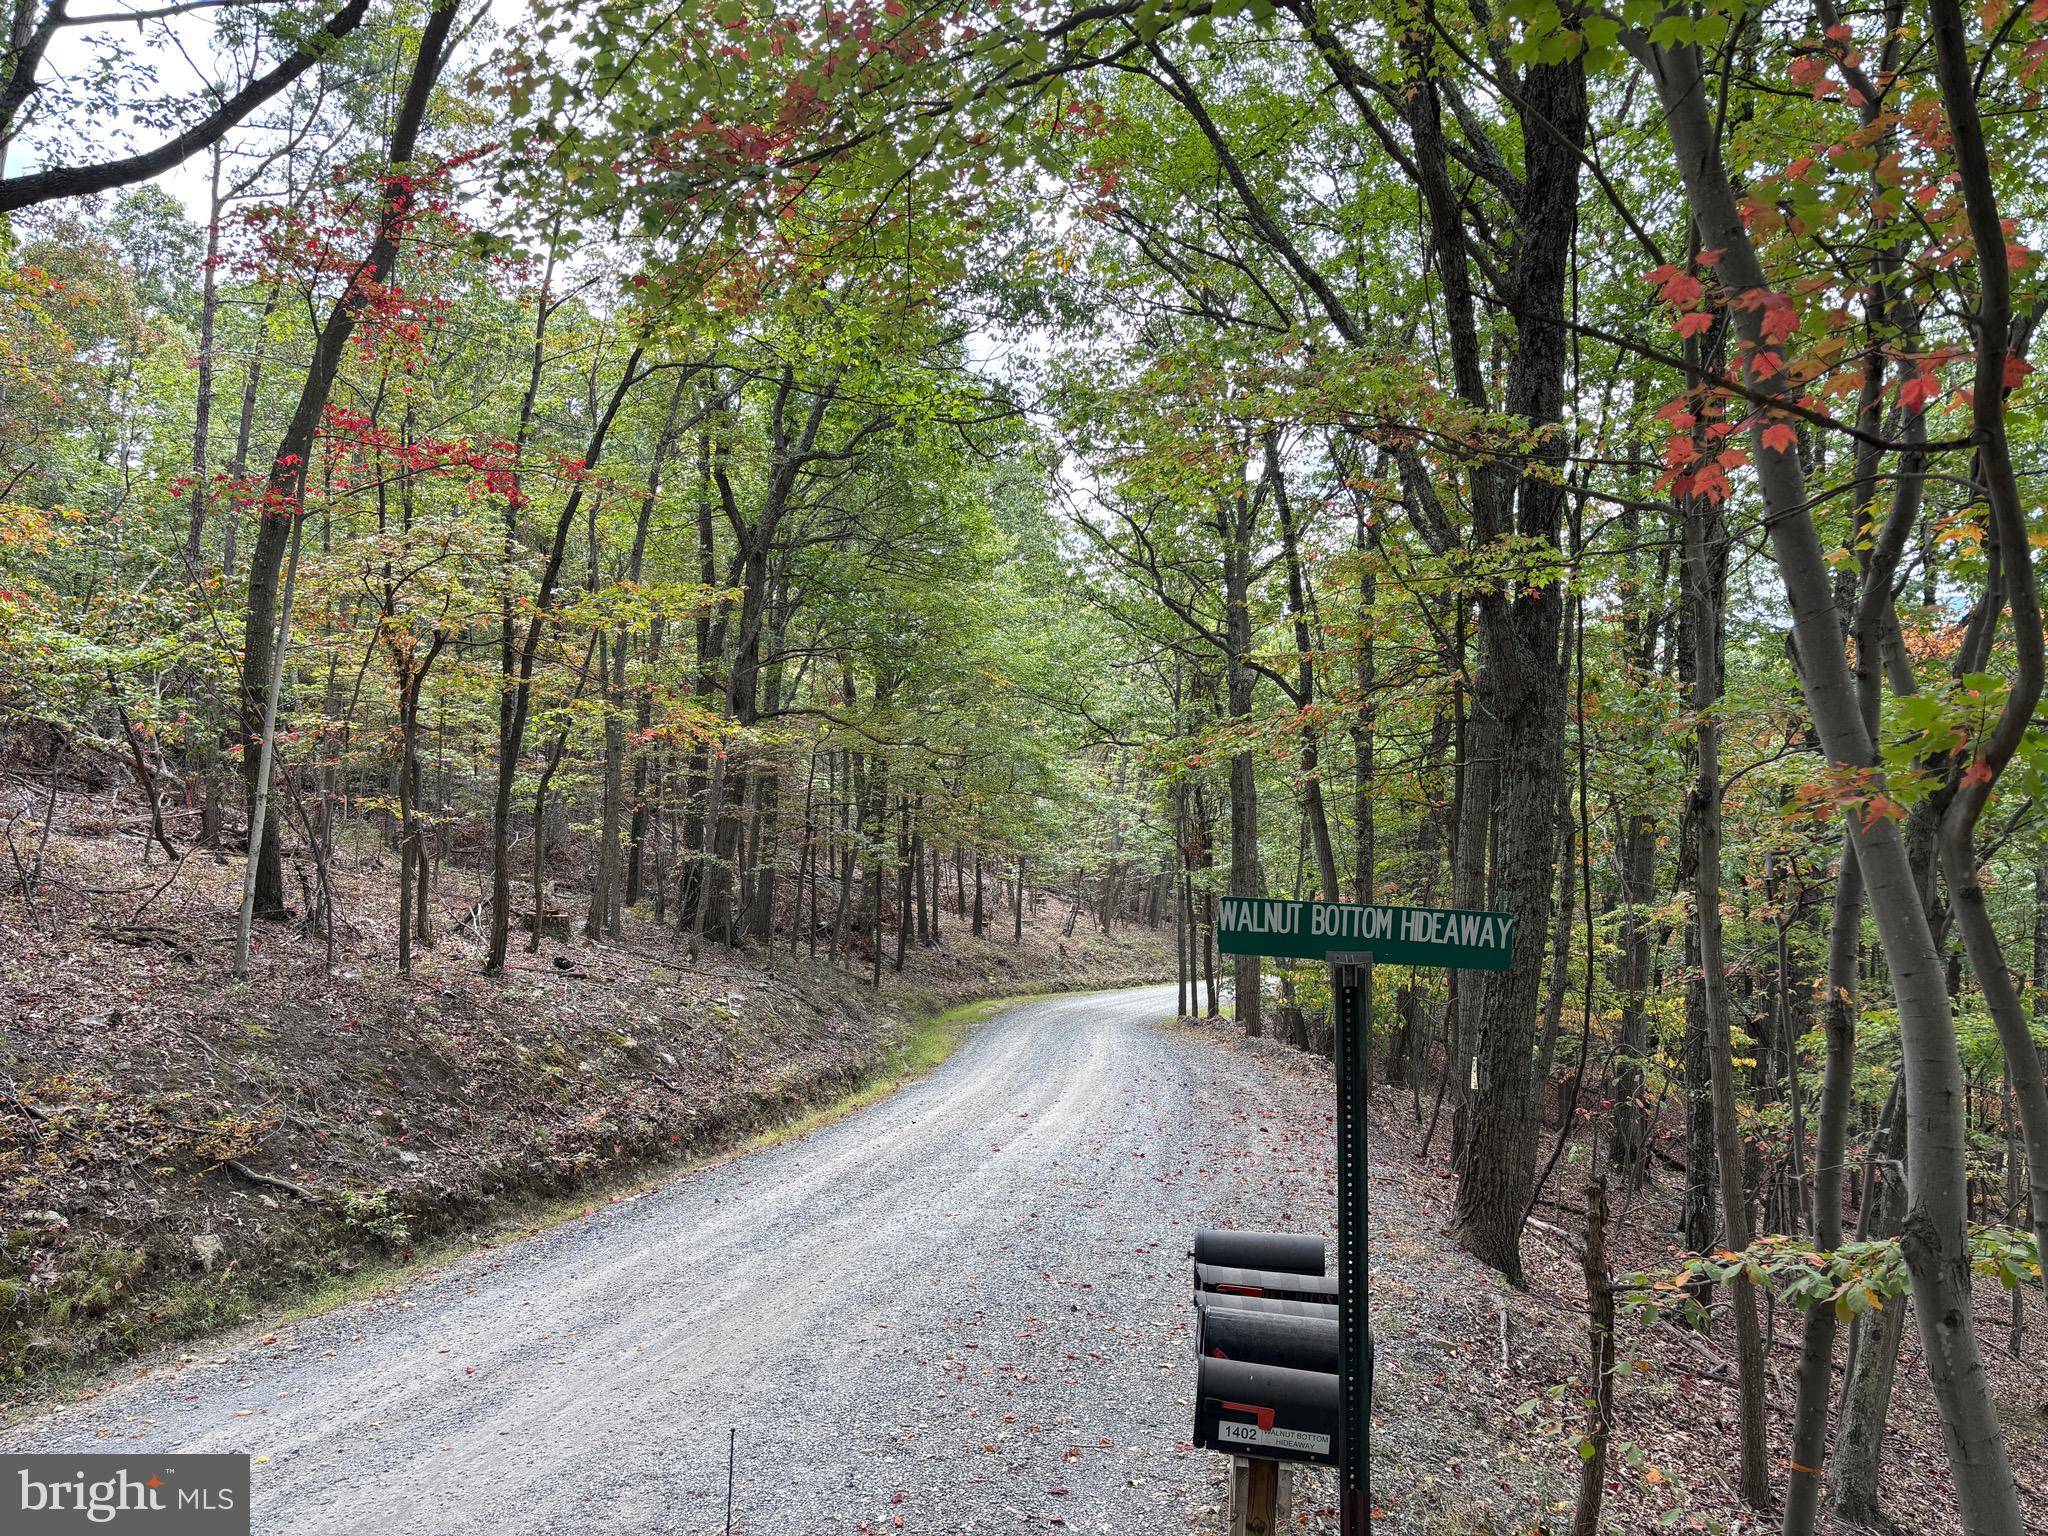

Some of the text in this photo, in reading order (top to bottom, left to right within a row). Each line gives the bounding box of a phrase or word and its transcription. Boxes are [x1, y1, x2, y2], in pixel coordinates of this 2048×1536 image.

[1218, 900, 1513, 949] WALNUT BOTTOM HIDEAWAY
[1225, 1425, 1257, 1440] 1402
[1296, 1432, 1329, 1443] BOTTOM
[1275, 1439, 1316, 1450] HIDEAWAY
